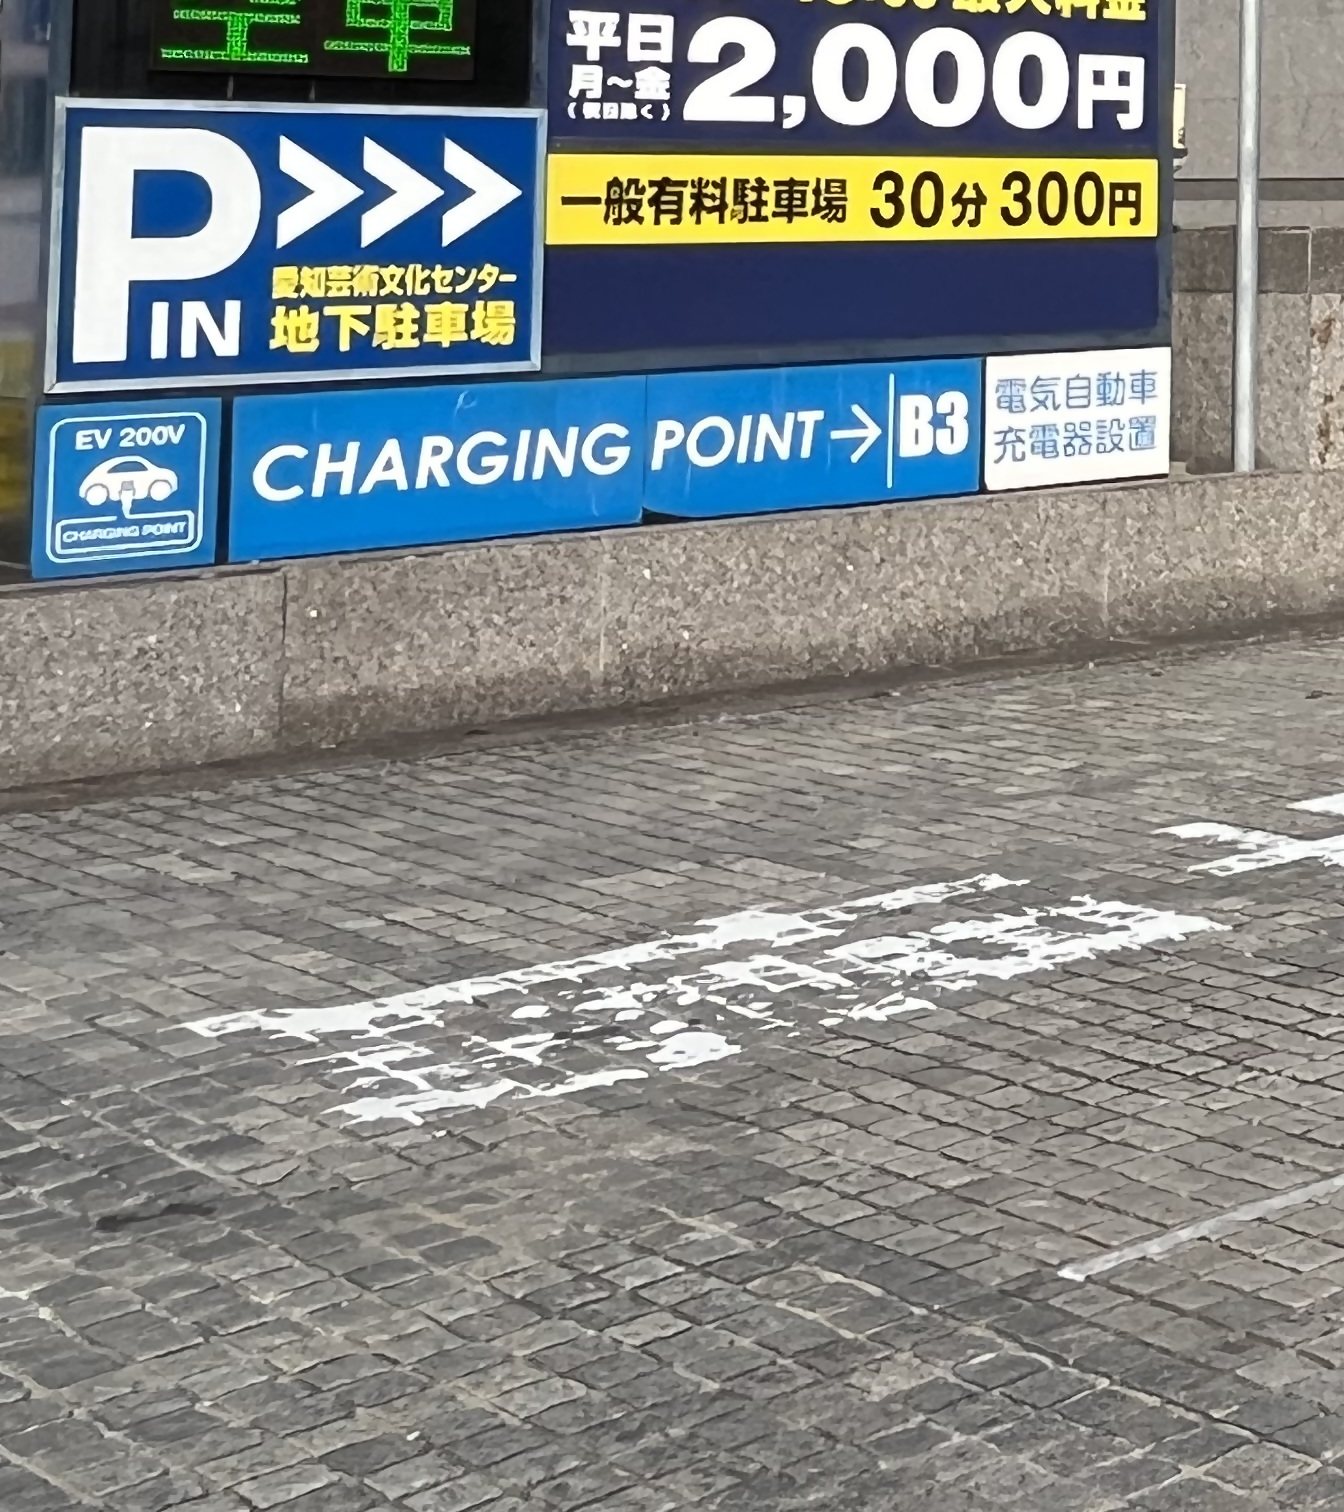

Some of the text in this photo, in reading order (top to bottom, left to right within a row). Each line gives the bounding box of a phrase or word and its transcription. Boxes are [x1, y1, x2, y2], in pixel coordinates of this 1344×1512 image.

[565, 9, 675, 64] 平日
[682, 15, 1146, 131] 2,000円
[561, 170, 1142, 229] 一般有料駐車場 30分 300円
[271, 263, 518, 300] 愛知芸術文化センター
[269, 300, 517, 353] 地下駐車場
[995, 369, 1159, 414] 電気自動車
[75, 423, 186, 451] EV 200V
[252, 390, 970, 503] CHARGING POINT B3
[993, 414, 1158, 464] 充電器設置
[141, 521, 188, 536] POINT
